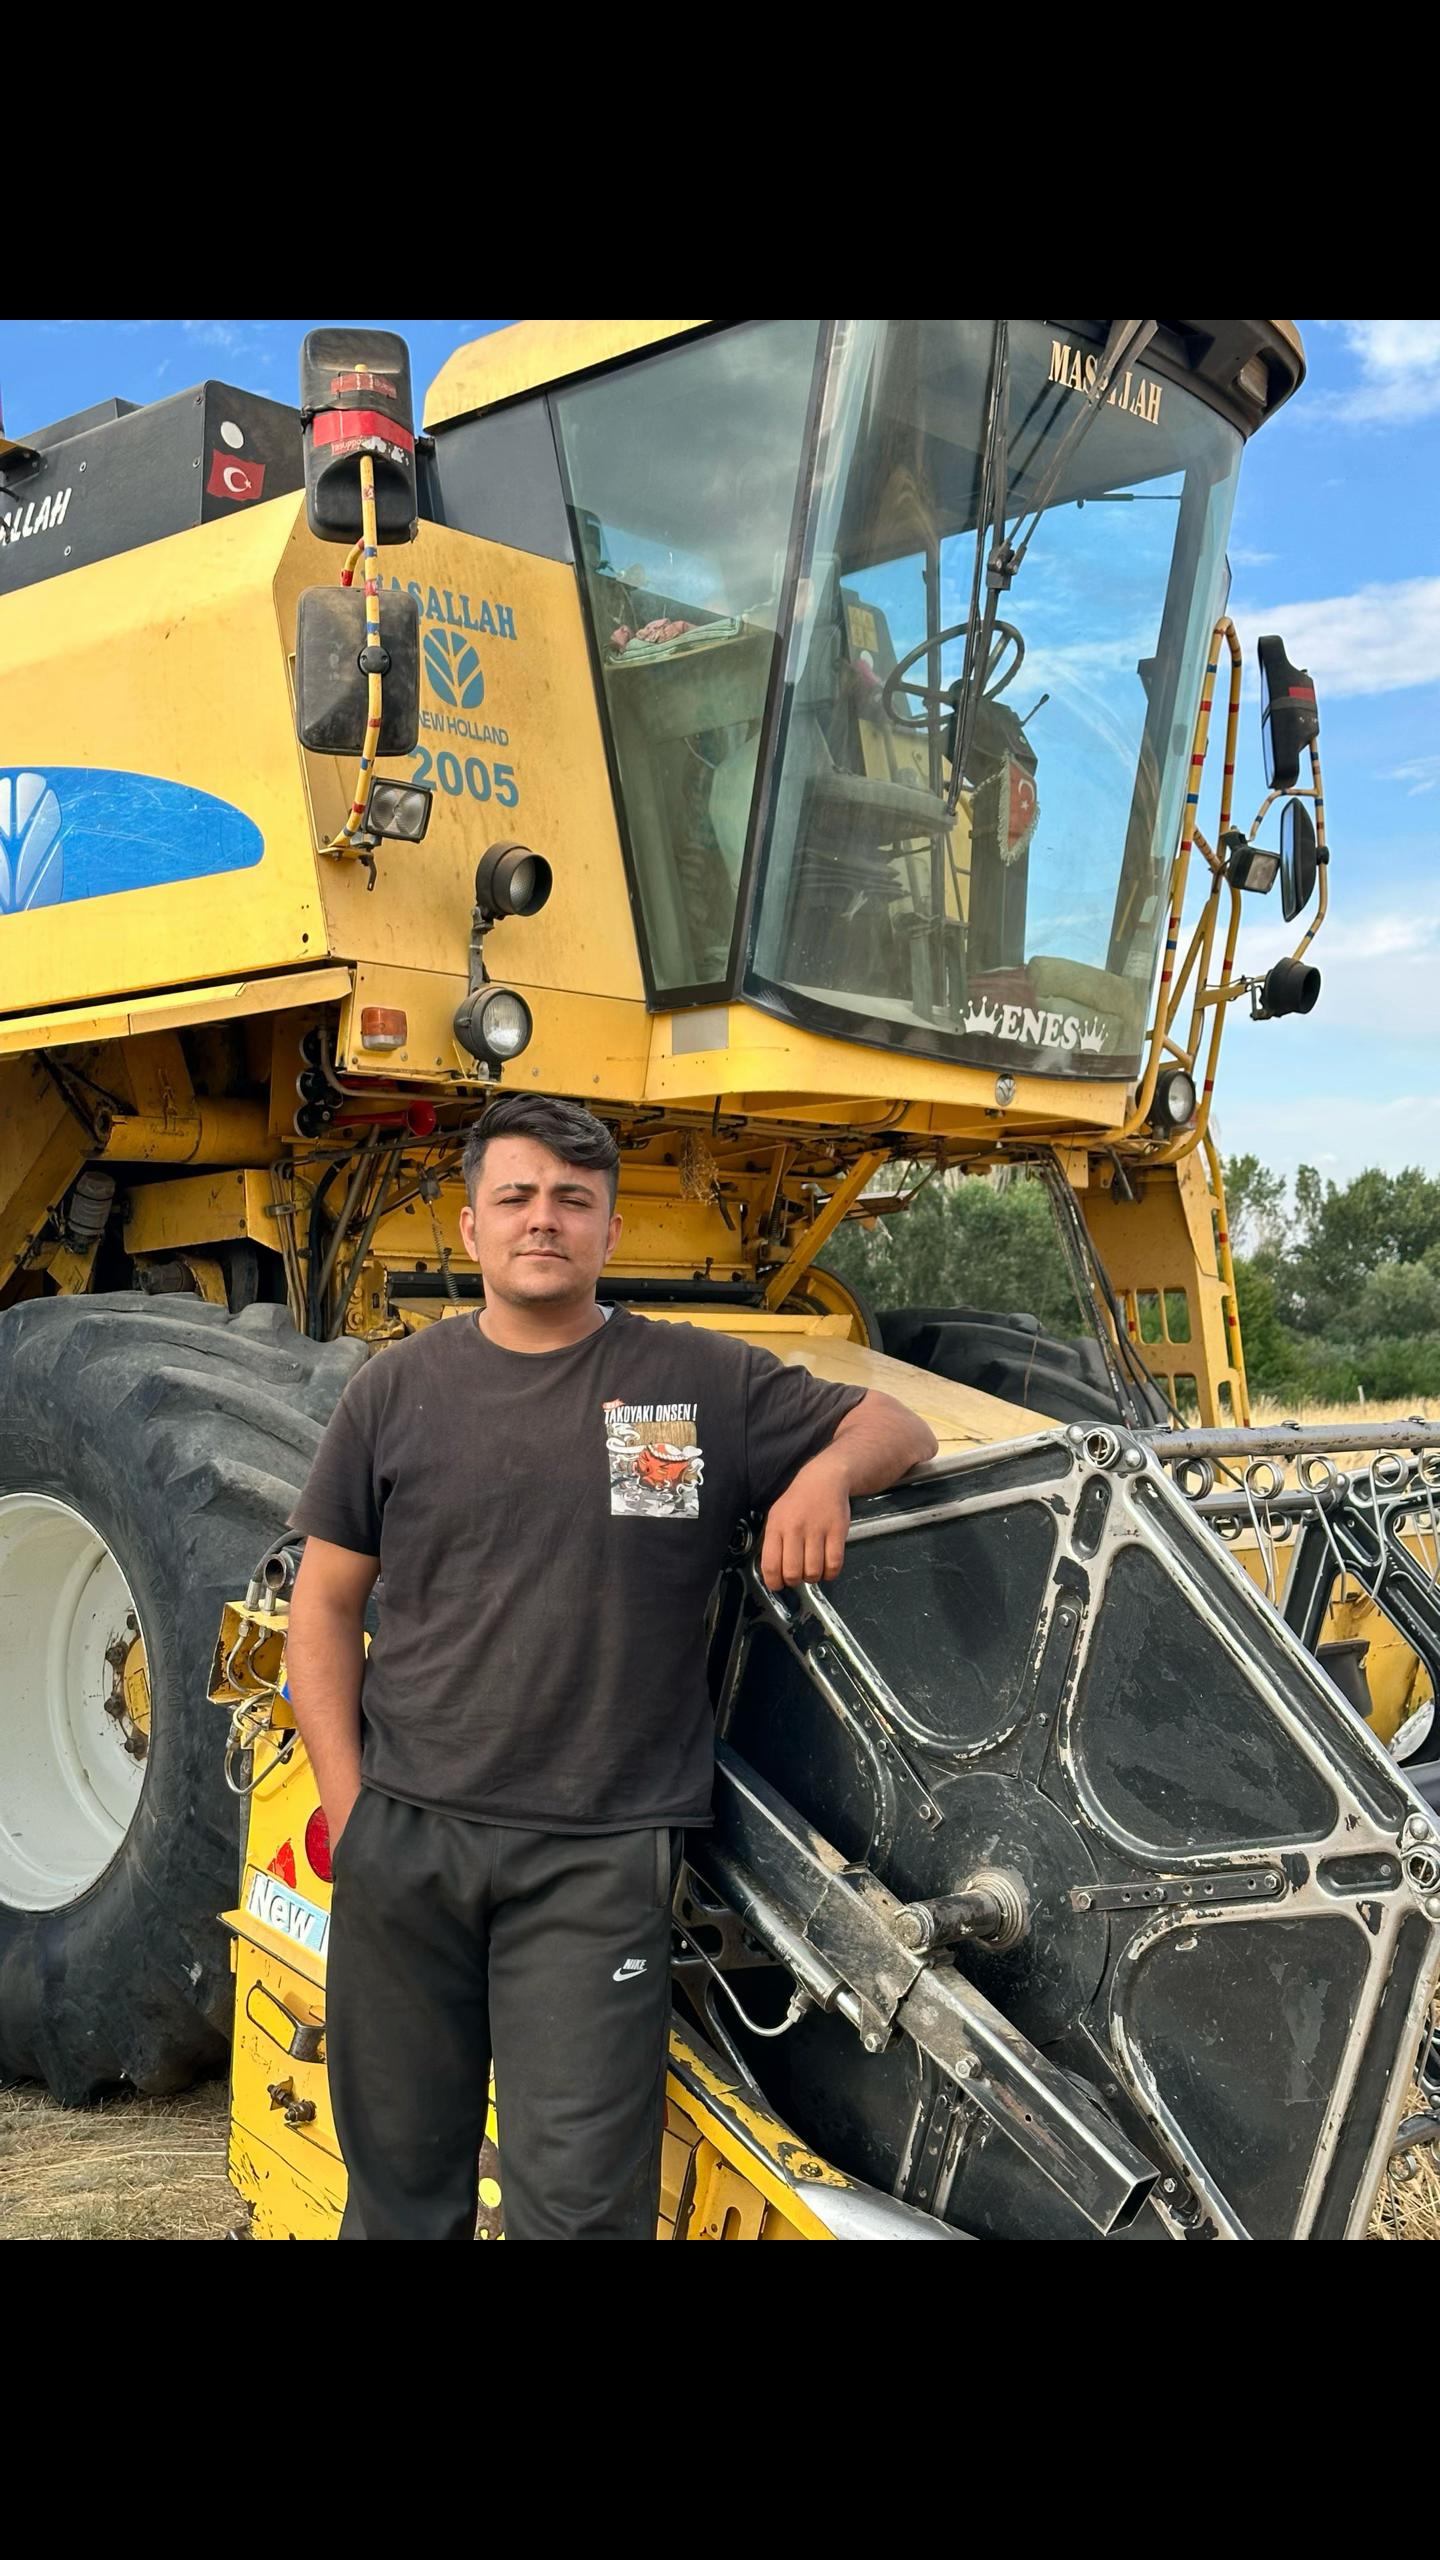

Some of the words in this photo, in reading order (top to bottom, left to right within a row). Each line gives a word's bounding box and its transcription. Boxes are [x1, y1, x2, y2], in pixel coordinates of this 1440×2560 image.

[361, 570, 518, 641] SALLAH
[418, 710, 445, 733] EW
[447, 716, 509, 747] HOLLAND
[408, 745, 519, 808] 2005
[998, 1004, 1080, 1050] ENES
[604, 1405, 653, 1425] TAKOYAKI
[249, 1873, 316, 1945] New
[623, 1958, 647, 1970] NIKE
